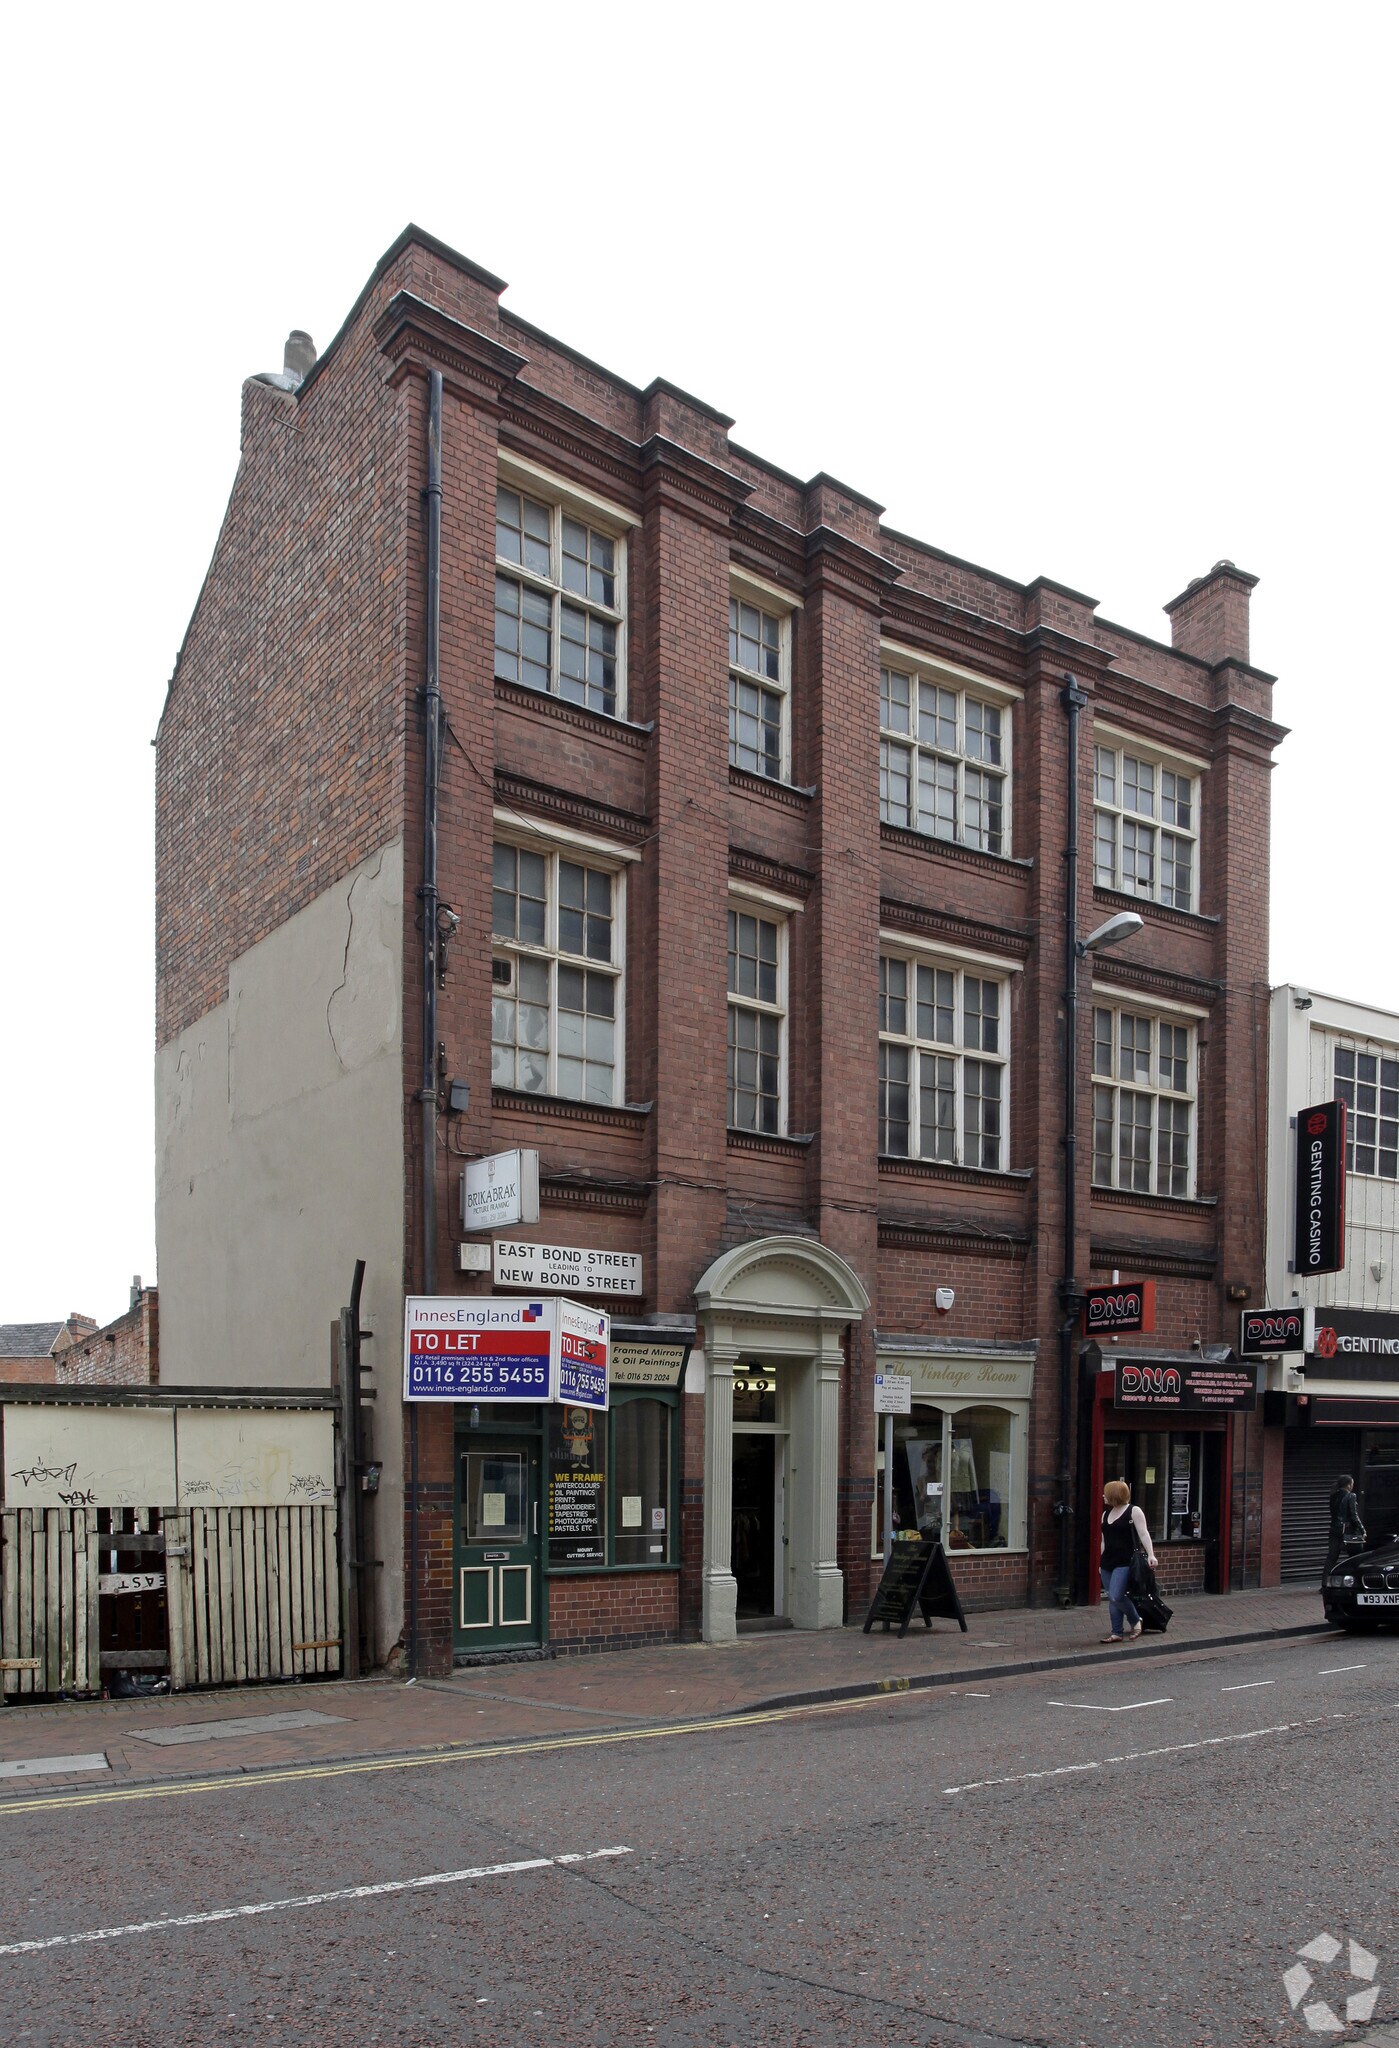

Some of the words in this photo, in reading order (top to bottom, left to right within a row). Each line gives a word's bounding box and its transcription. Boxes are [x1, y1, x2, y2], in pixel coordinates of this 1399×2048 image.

[1310, 1140, 1323, 1207] GENTING
[467, 1183, 516, 1208] BRIKABRAK
[473, 1204, 490, 1214] PICTURE
[490, 1200, 510, 1211] FRAMING
[1309, 1209, 1322, 1265] CASINO
[498, 1244, 535, 1258] EAST
[542, 1248, 581, 1263] BOND
[588, 1252, 637, 1268] STREET
[548, 1263, 580, 1272] LEADING
[500, 1268, 533, 1282] NEW
[540, 1272, 580, 1286] BOND
[586, 1276, 636, 1291] STREET
[1089, 1293, 1140, 1320] DNA
[415, 1309, 520, 1326] InnesEngland
[1247, 1315, 1301, 1340] DNA
[414, 1333, 439, 1350] TO
[445, 1333, 481, 1350] LET
[562, 1336, 572, 1354] TO
[1341, 1335, 1399, 1355] GENTING
[441, 1355, 465, 1363] premises
[613, 1346, 649, 1355] Framed
[651, 1348, 684, 1357] Mirrors
[612, 1356, 620, 1364] &
[622, 1357, 637, 1365] Oil
[639, 1358, 681, 1369] Paintings
[413, 1367, 454, 1382] 0116
[460, 1367, 494, 1383] 255
[499, 1367, 545, 1384] 5455
[561, 1369, 576, 1387] 0116
[614, 1372, 625, 1380] Tel:
[627, 1372, 640, 1381] 0116
[642, 1373, 652, 1381] 251
[654, 1373, 670, 1381] 2024
[892, 1360, 913, 1376] The
[919, 1361, 973, 1388] Vintage
[976, 1364, 1020, 1383] Room
[1122, 1366, 1181, 1394] DNA
[413, 1385, 507, 1394] www.innes-england.com
[555, 1473, 570, 1482] WE
[554, 1503, 596, 1511] EMBROIDERIES
